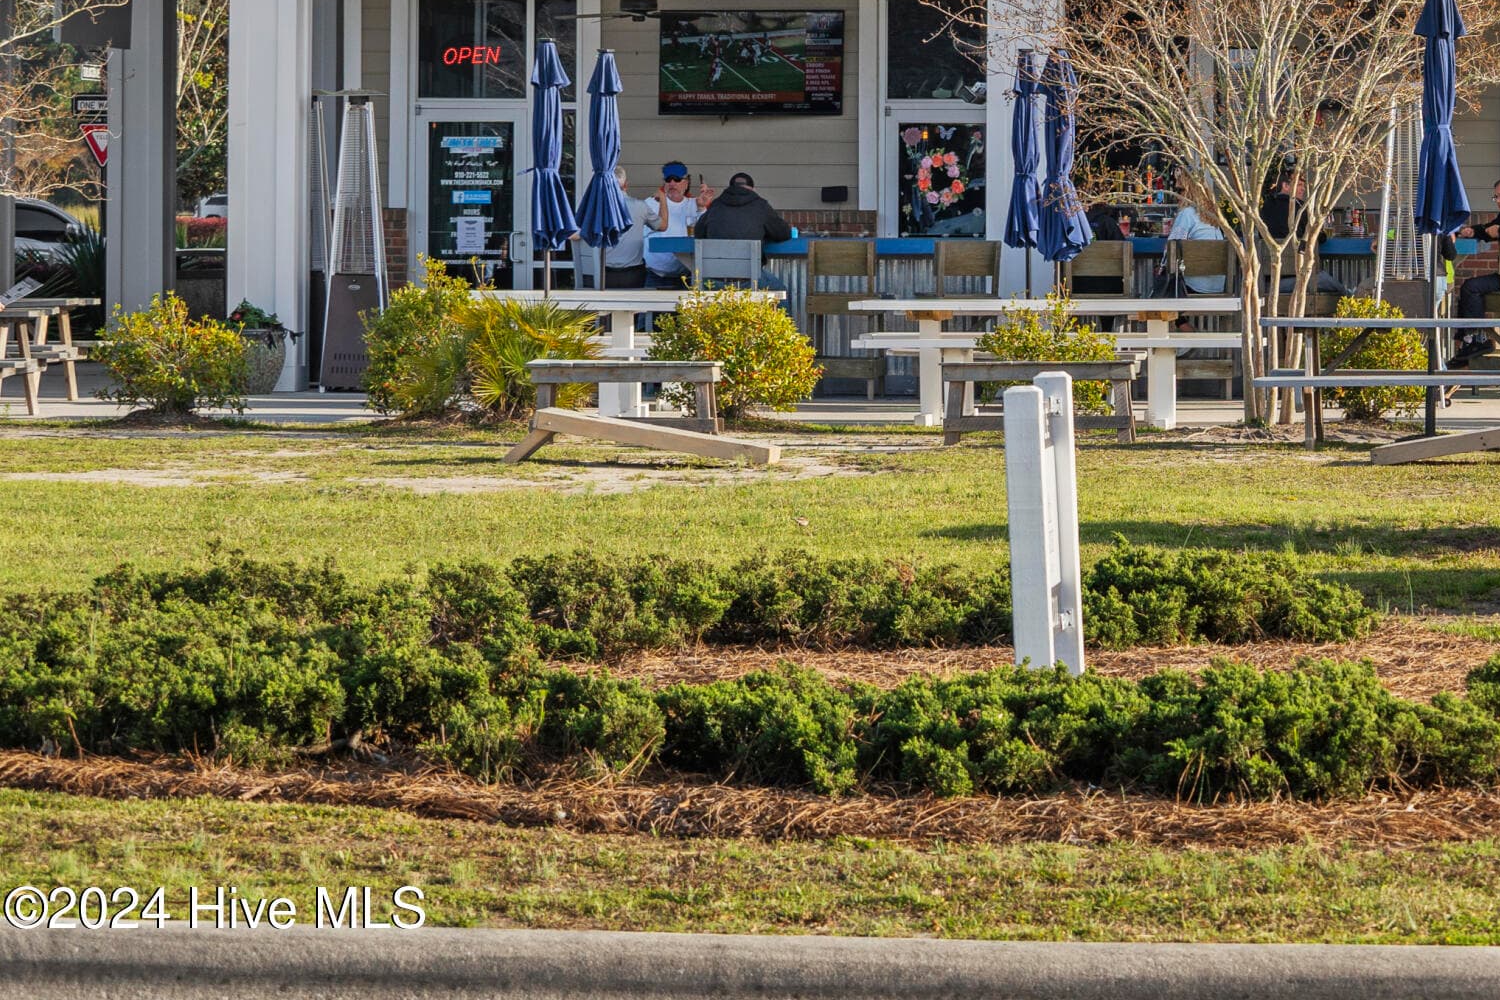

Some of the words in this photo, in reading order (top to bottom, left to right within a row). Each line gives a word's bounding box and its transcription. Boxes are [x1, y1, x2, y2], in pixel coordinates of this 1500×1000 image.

[443, 46, 501, 65] OPEN
[79, 101, 95, 109] ONE
[98, 101, 108, 109] WA
[463, 208, 480, 216] HOURS
